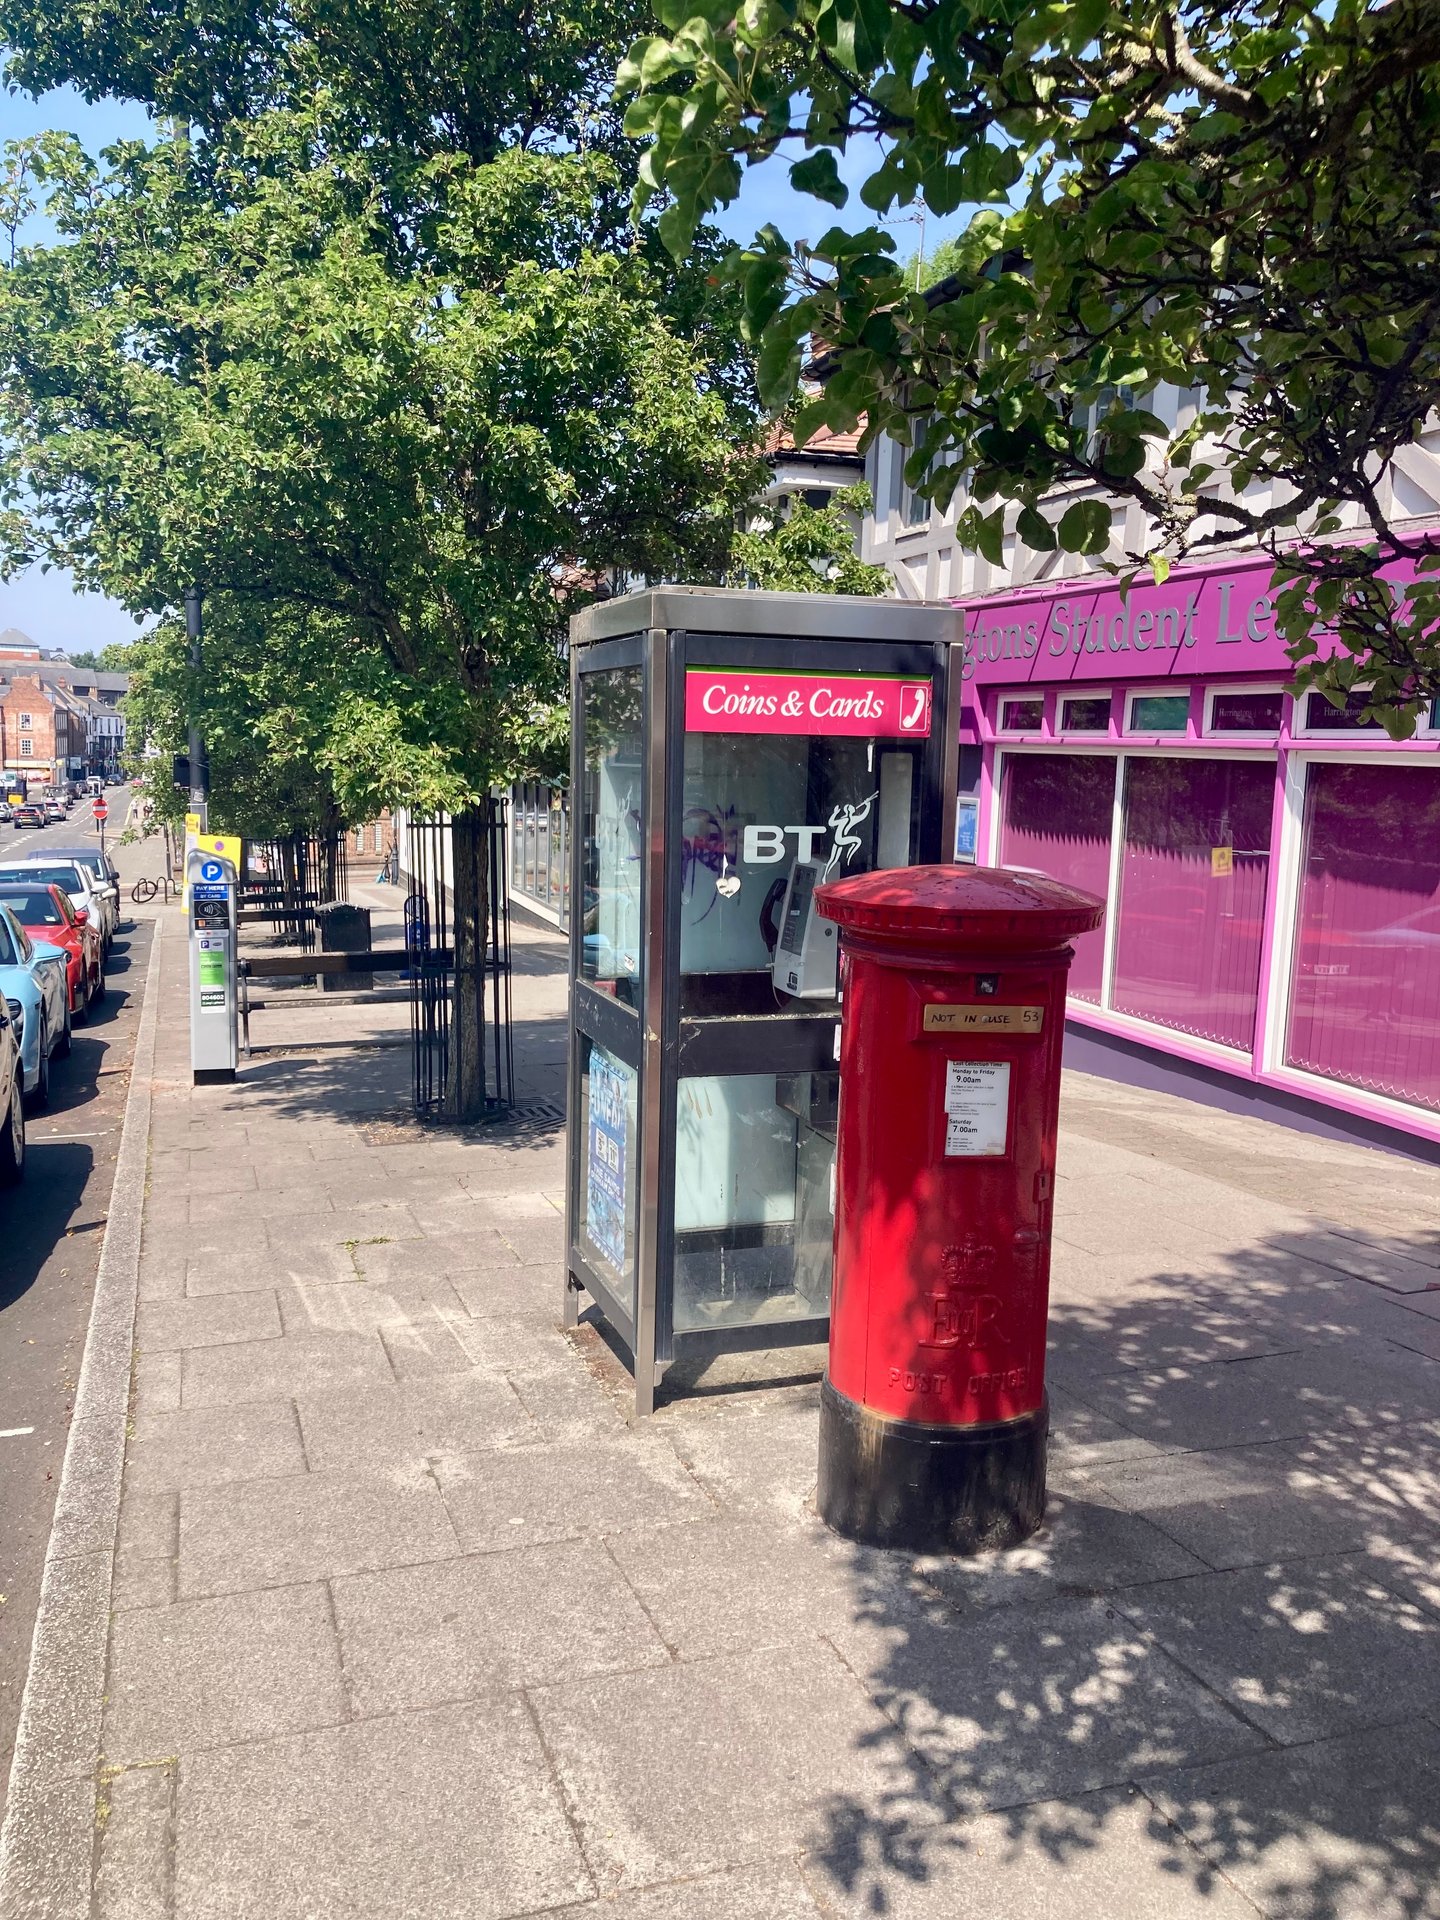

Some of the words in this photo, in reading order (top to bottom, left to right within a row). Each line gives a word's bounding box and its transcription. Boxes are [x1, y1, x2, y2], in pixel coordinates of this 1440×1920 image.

[1049, 591, 1198, 656] Student
[703, 684, 778, 715] Coins
[780, 691, 804, 717] &
[809, 688, 884, 719] Cards
[743, 825, 827, 864] BT
[207, 865, 218, 878] P
[931, 1013, 956, 1023] NOT
[964, 1015, 977, 1023] IN
[988, 1014, 1011, 1023] USE
[1023, 1010, 1039, 1022] 53
[956, 1075, 982, 1083] 9.00am
[953, 1124, 978, 1133] 7.00am
[888, 1367, 947, 1394] POST
[967, 1367, 1027, 1394] OFFICE
